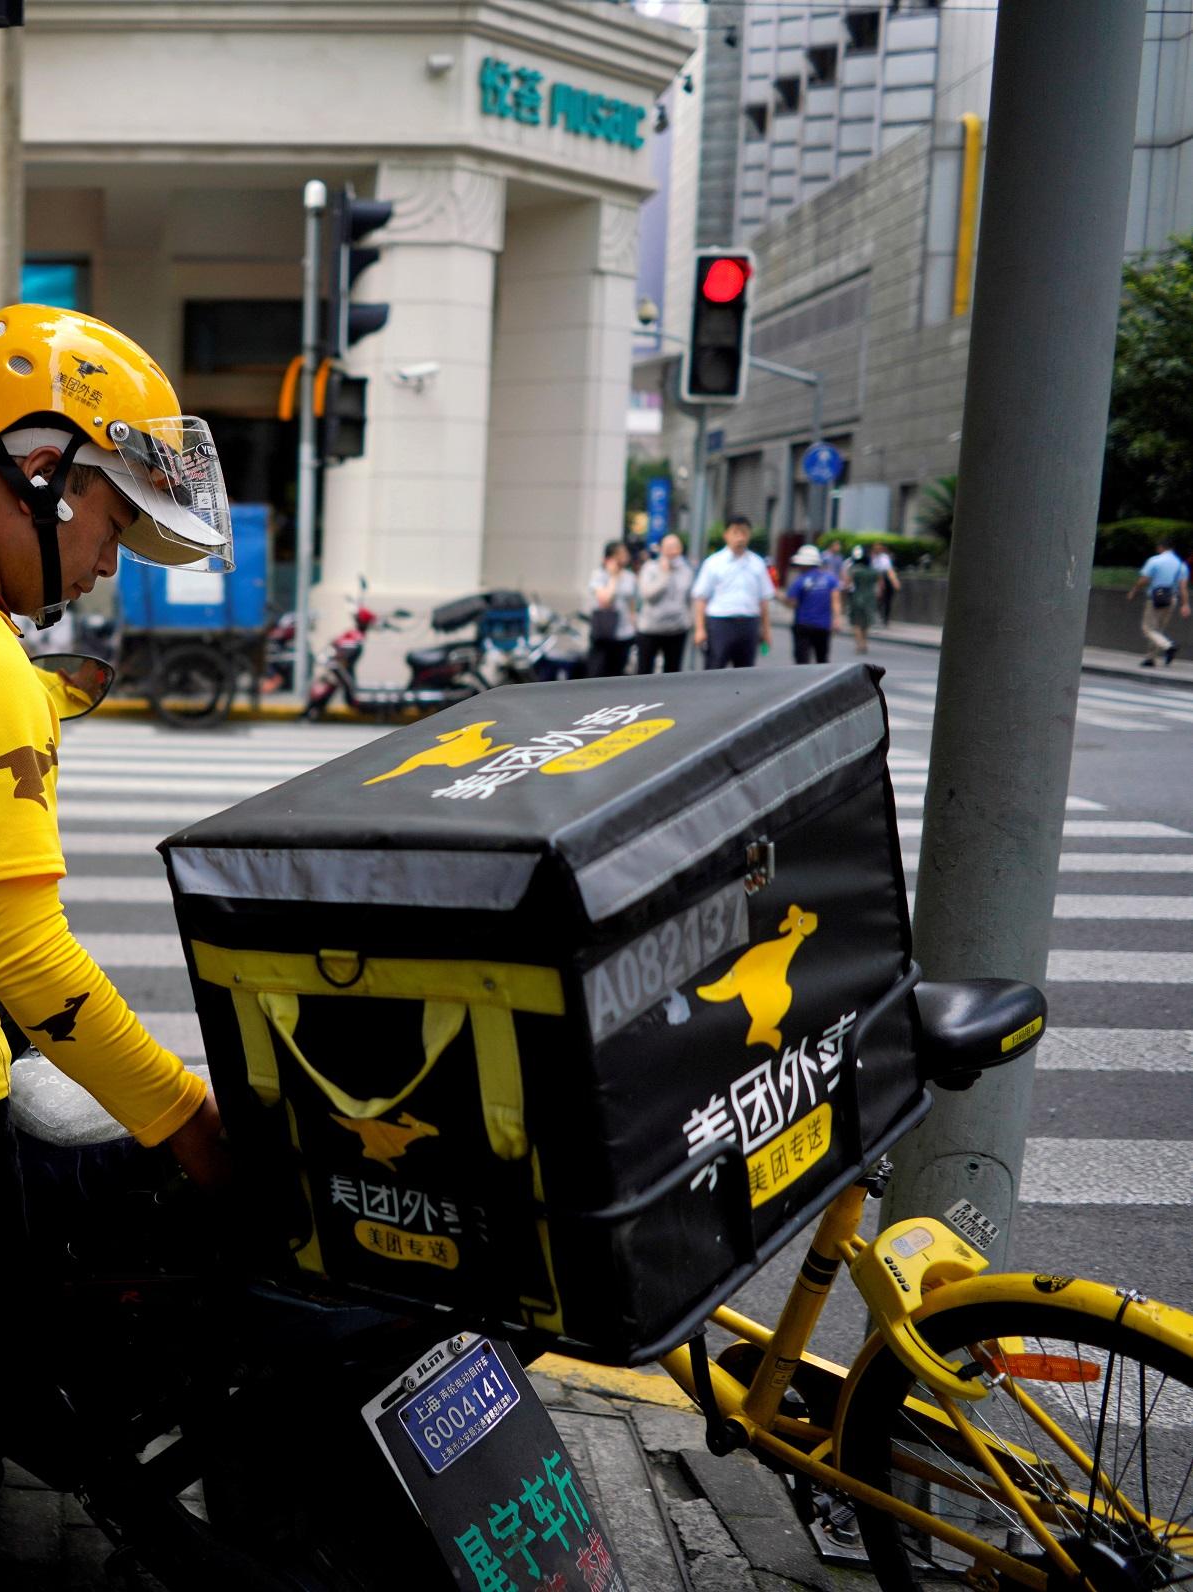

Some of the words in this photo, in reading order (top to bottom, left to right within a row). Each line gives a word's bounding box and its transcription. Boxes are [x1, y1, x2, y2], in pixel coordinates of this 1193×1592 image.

[54, 371, 103, 405] 美团外卖
[431, 702, 664, 799] 美团外卖
[592, 880, 747, 1042] A082137
[750, 1114, 824, 1197] 美团专送
[367, 1226, 448, 1263] 美团专送
[414, 1395, 442, 1424] 上海
[439, 1355, 489, 1401] 两轮电动自行车
[423, 1369, 504, 1449] 6004141
